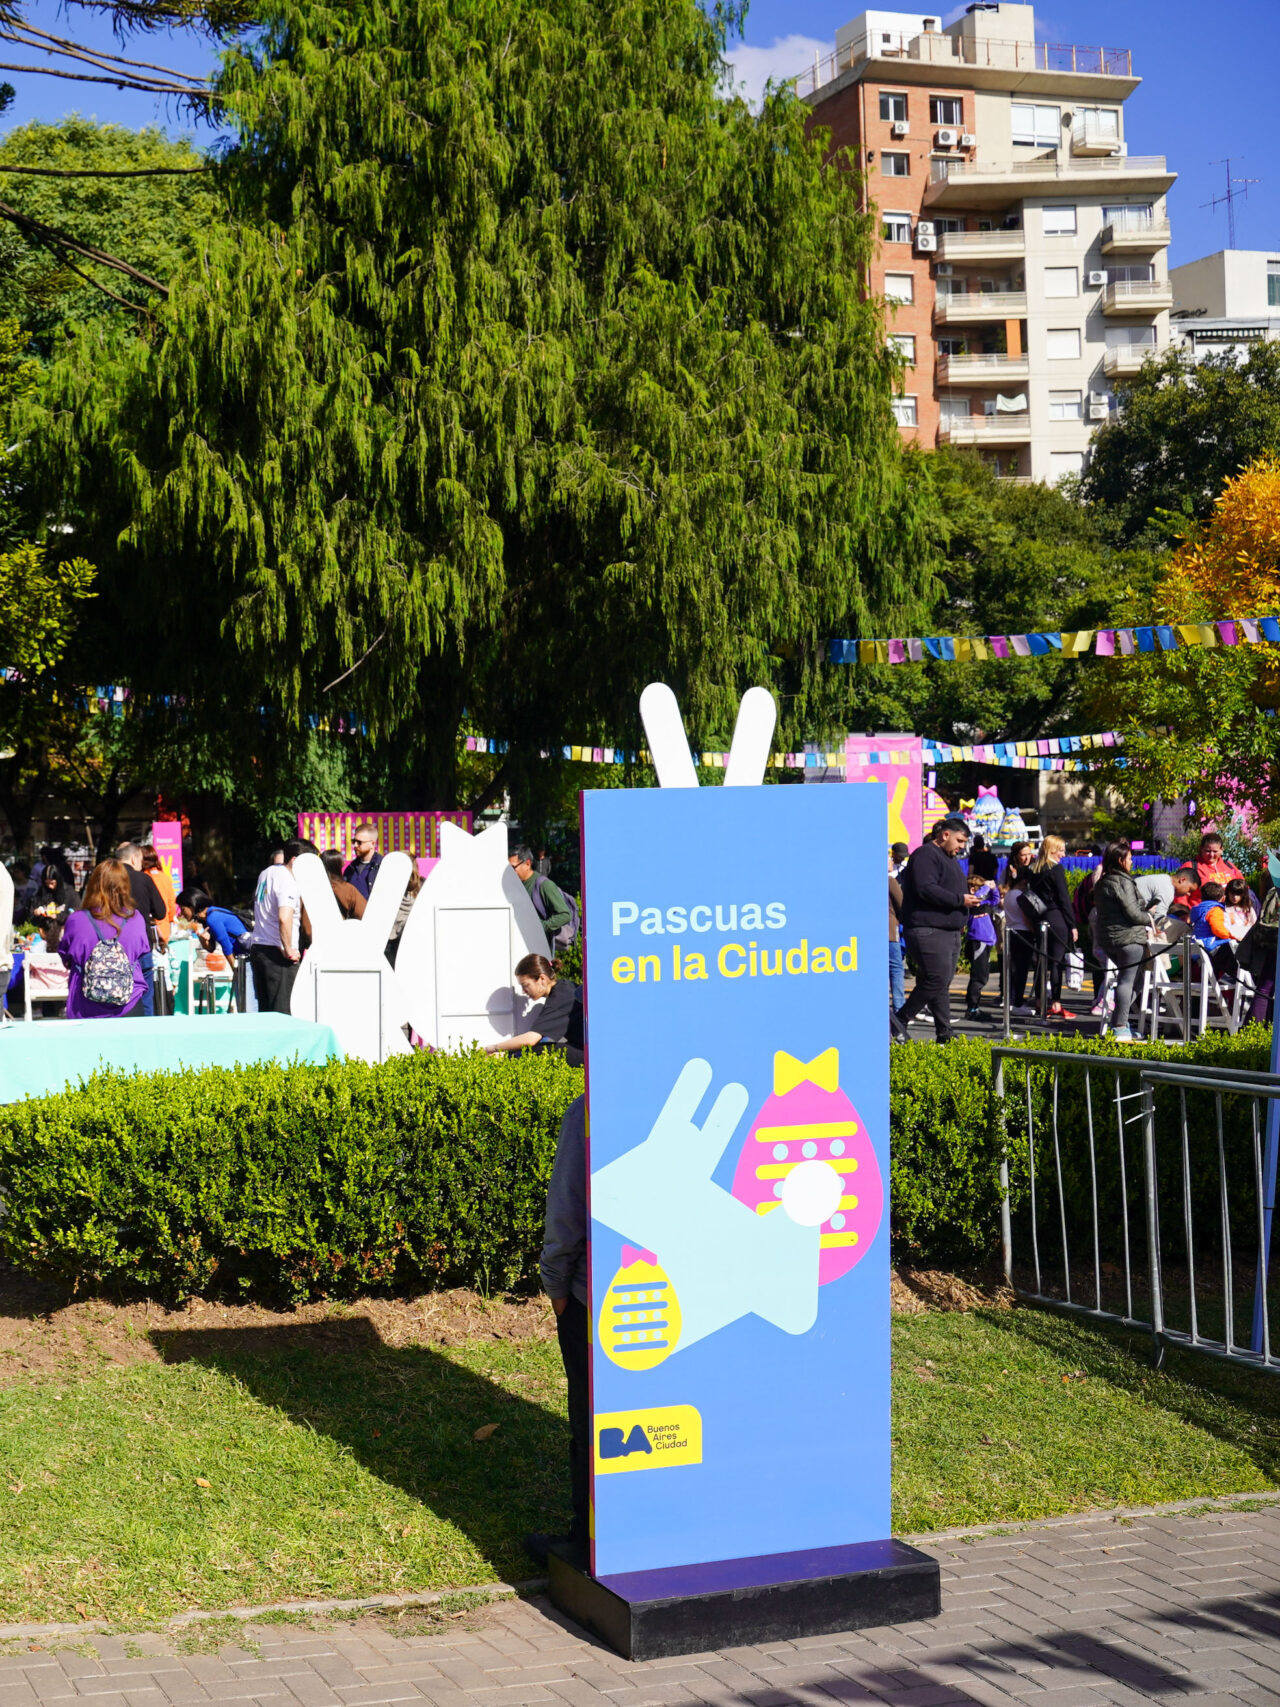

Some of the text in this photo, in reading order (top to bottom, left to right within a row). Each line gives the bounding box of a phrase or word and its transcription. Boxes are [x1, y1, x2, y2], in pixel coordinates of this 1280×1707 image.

[612, 901, 787, 936] Pascuas
[611, 936, 858, 984] en la Ciudad
[647, 1424, 680, 1434] Buenos
[653, 1433, 677, 1442] Aires
[599, 1424, 653, 1459] BA
[655, 1438, 688, 1450] Ciudad
